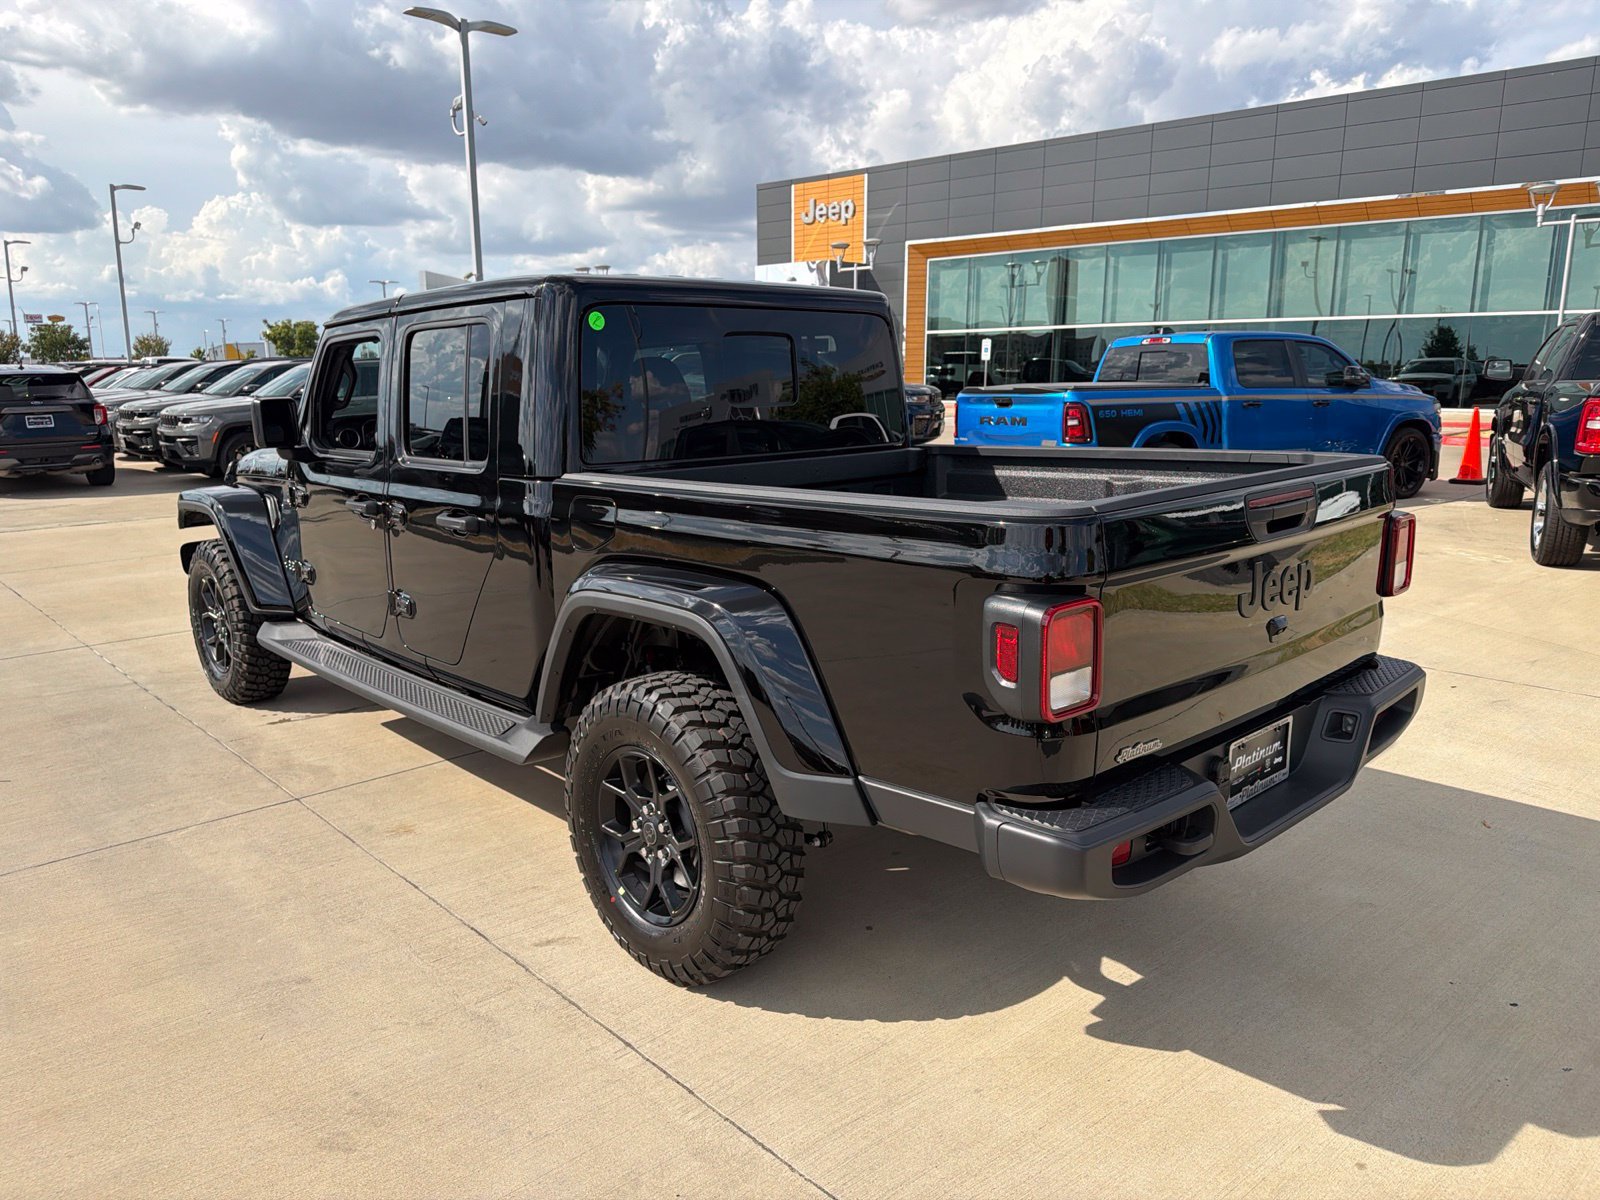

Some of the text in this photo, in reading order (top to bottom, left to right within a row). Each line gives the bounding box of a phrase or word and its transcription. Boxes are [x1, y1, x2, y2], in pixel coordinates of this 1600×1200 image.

[801, 197, 856, 226] Jeep
[979, 415, 1028, 427] RAM
[1098, 408, 1144, 418] 650 HEMI
[1237, 560, 1314, 618] Jeep
[1115, 738, 1162, 764] Platinum
[1230, 740, 1283, 773] Platinum
